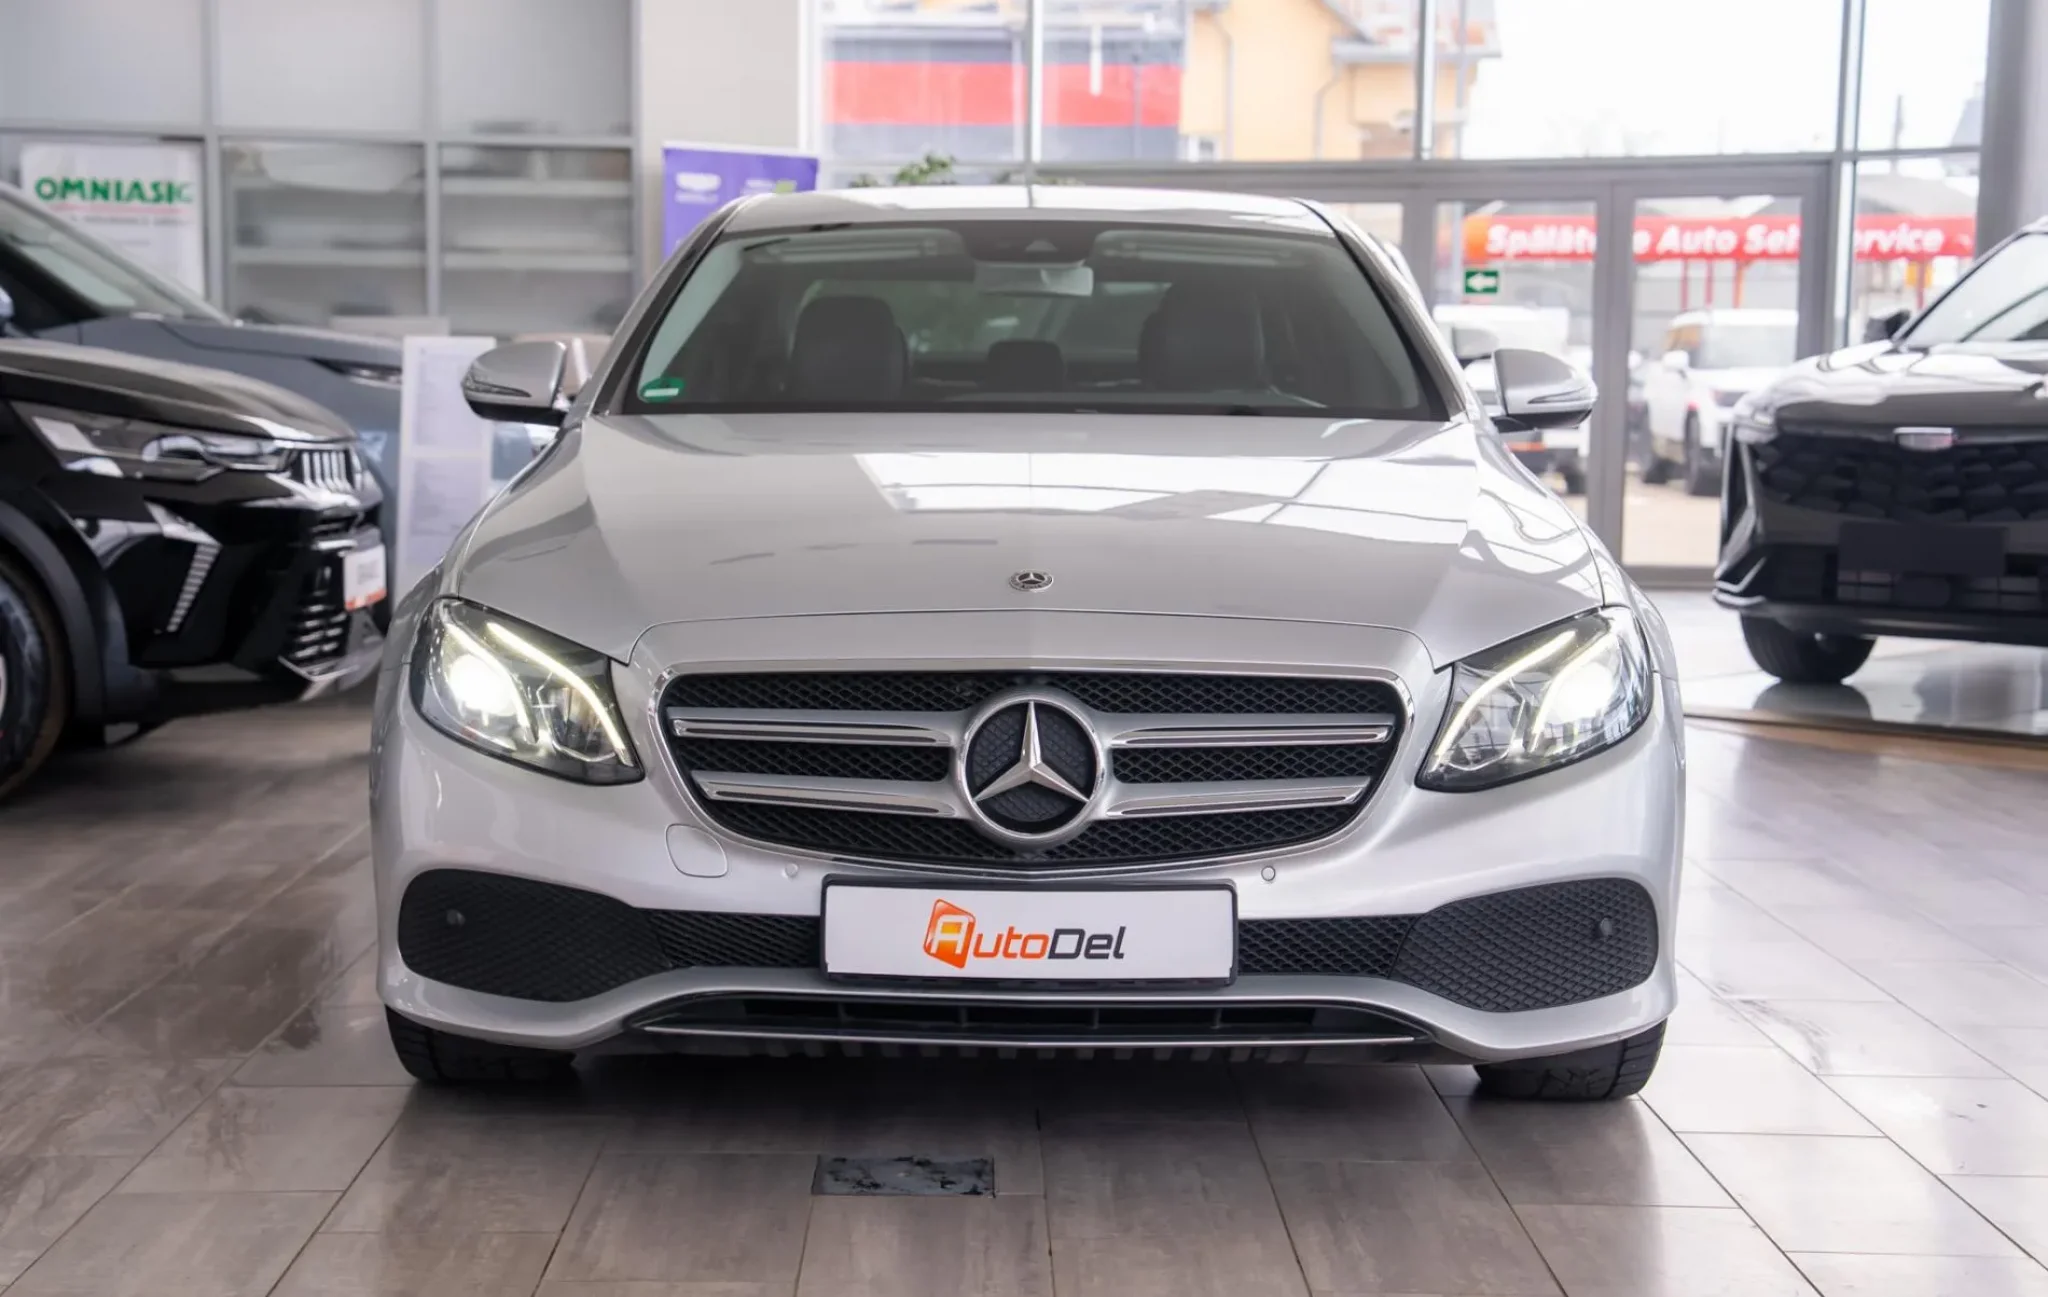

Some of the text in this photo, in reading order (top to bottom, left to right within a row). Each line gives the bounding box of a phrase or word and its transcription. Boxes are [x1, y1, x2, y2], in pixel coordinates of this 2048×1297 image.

[1655, 224, 1738, 255] Auto
[1743, 223, 1800, 255] Sel
[1853, 222, 1944, 253] rvice
[928, 908, 1127, 962] AutoDel
